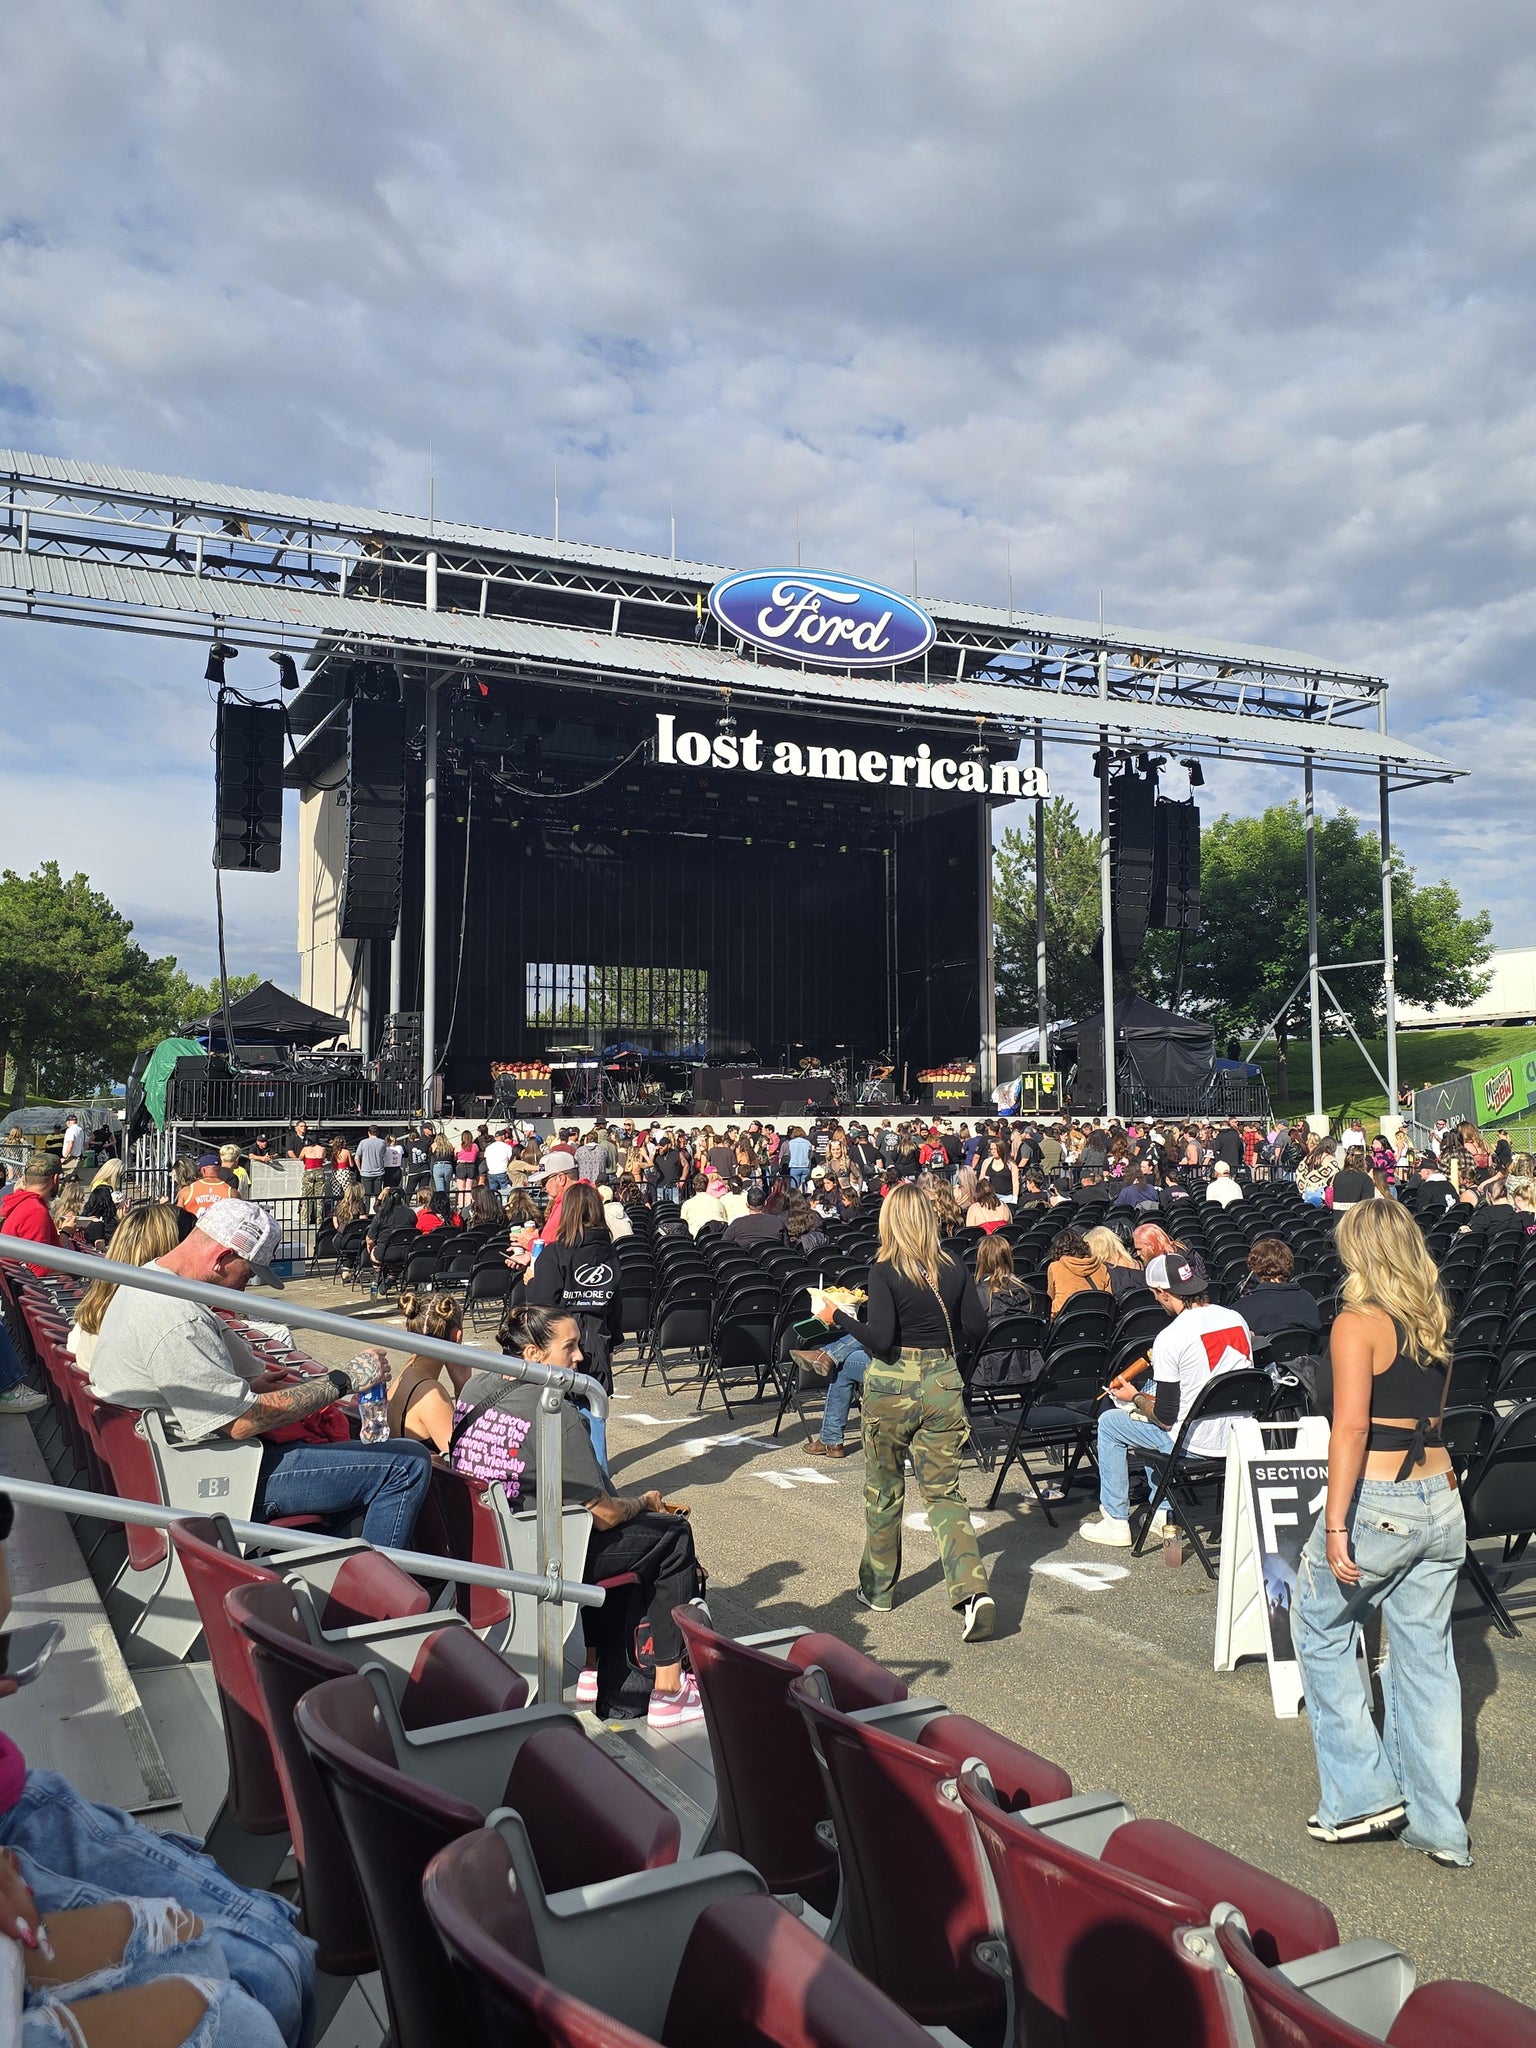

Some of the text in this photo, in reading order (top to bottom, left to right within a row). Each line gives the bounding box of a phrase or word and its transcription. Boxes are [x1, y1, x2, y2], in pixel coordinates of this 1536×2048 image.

[757, 580, 893, 653] Ford
[655, 713, 1052, 799] lost americana
[507, 1426, 525, 1442] the
[1255, 1466, 1328, 1480] SECTION
[208, 1479, 219, 1496] B
